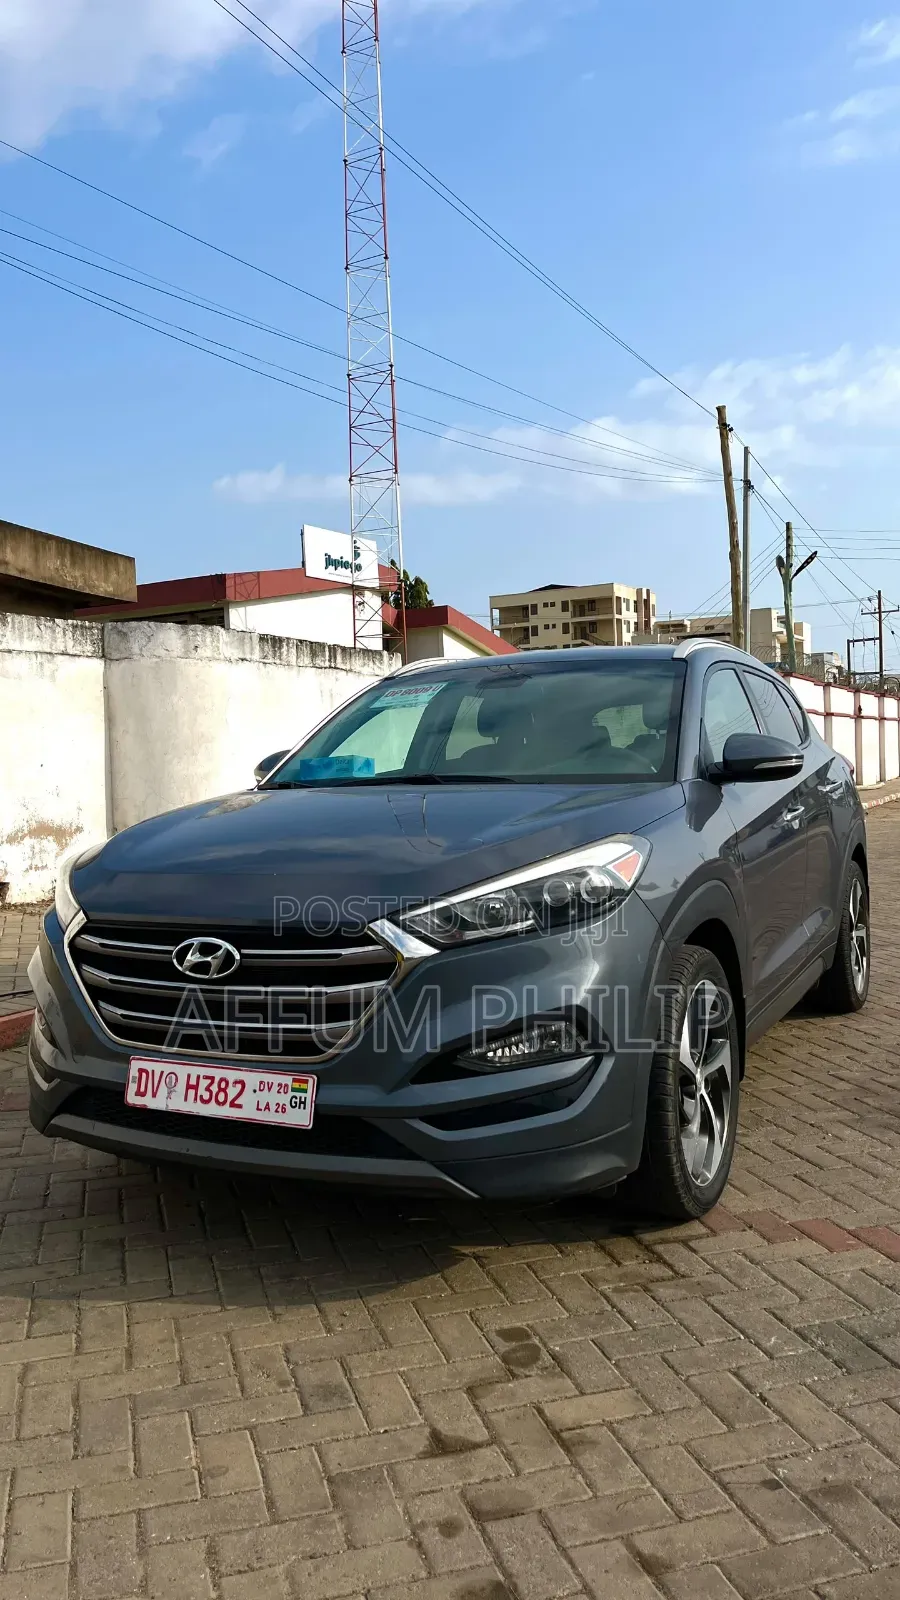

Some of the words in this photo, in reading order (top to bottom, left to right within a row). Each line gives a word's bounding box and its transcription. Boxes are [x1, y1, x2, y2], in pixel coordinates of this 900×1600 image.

[324, 553, 362, 573] jhpiego
[134, 1067, 165, 1099] DV
[183, 1073, 247, 1110] H382
[258, 1080, 274, 1093] DV
[276, 1082, 290, 1095] 20
[255, 1102, 271, 1113] LA
[274, 1102, 287, 1114] 26
[289, 1094, 307, 1111] GH
